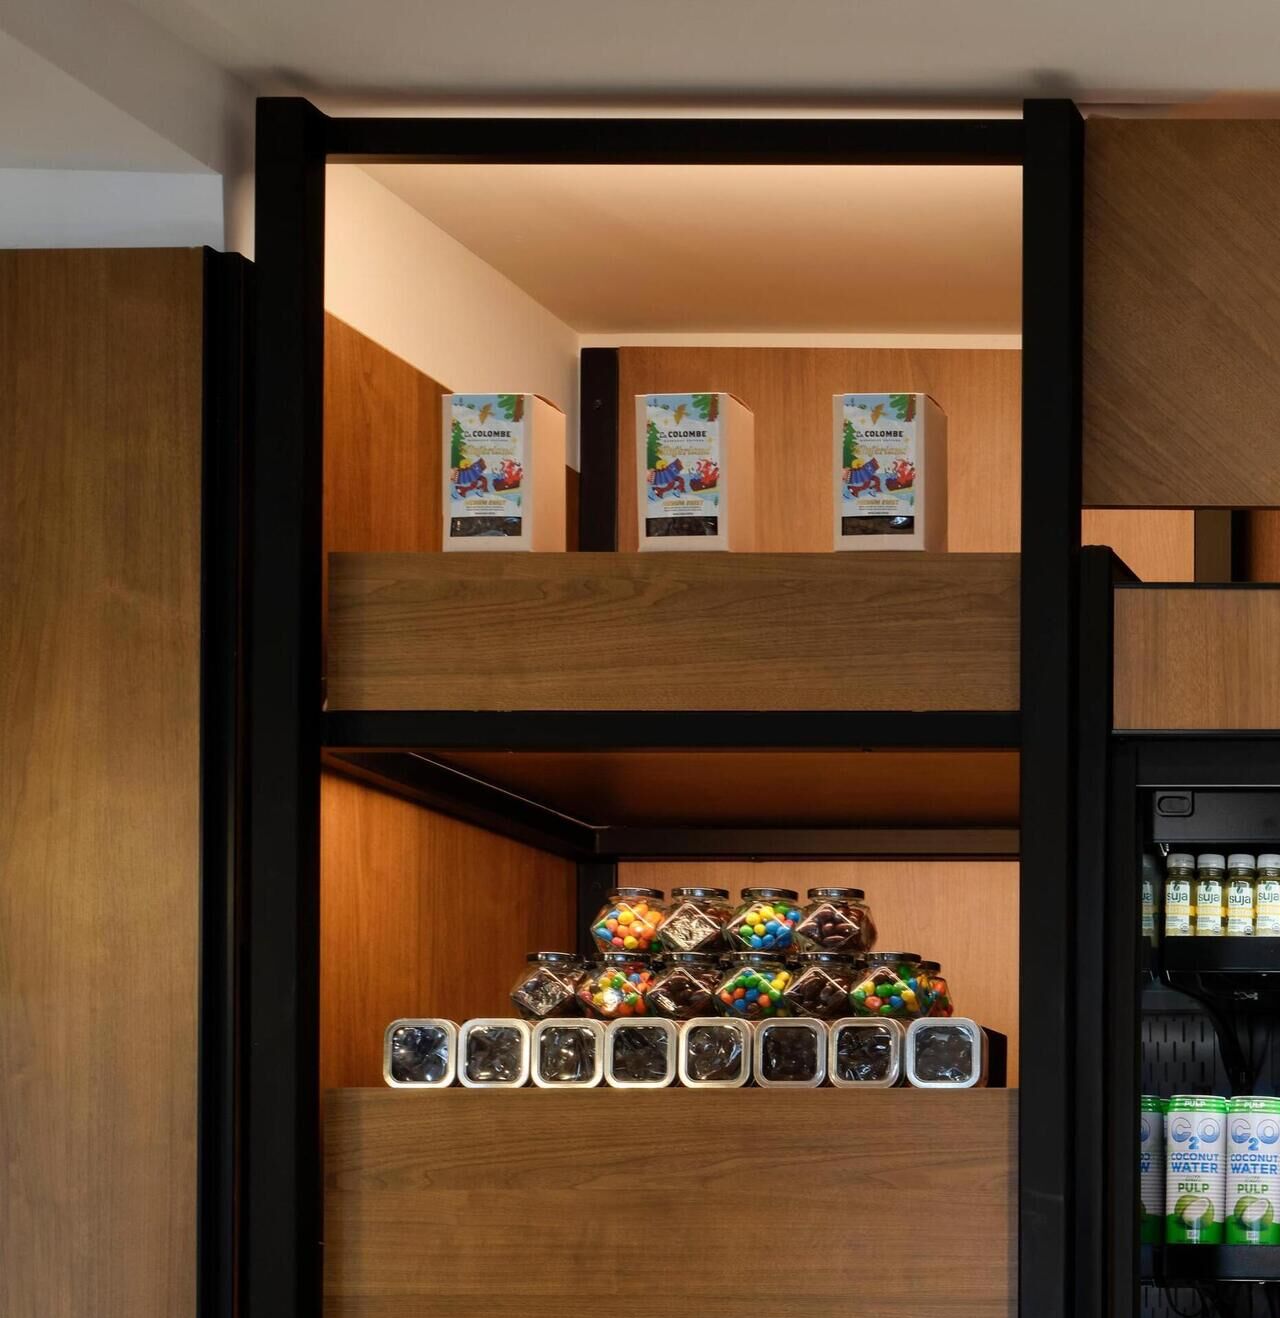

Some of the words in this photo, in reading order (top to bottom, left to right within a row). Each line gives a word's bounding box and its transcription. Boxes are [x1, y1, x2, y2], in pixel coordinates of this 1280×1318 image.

[668, 430, 706, 438] COLOMBE
[1167, 891, 1188, 903] suja
[1171, 1153, 1218, 1161] COCONUT
[1231, 1154, 1278, 1162] COCONUT
[1172, 1163, 1218, 1173] WATER
[1231, 1164, 1277, 1174] WATER
[1178, 1184, 1209, 1192] PULP
[1237, 1184, 1268, 1194] PULP
